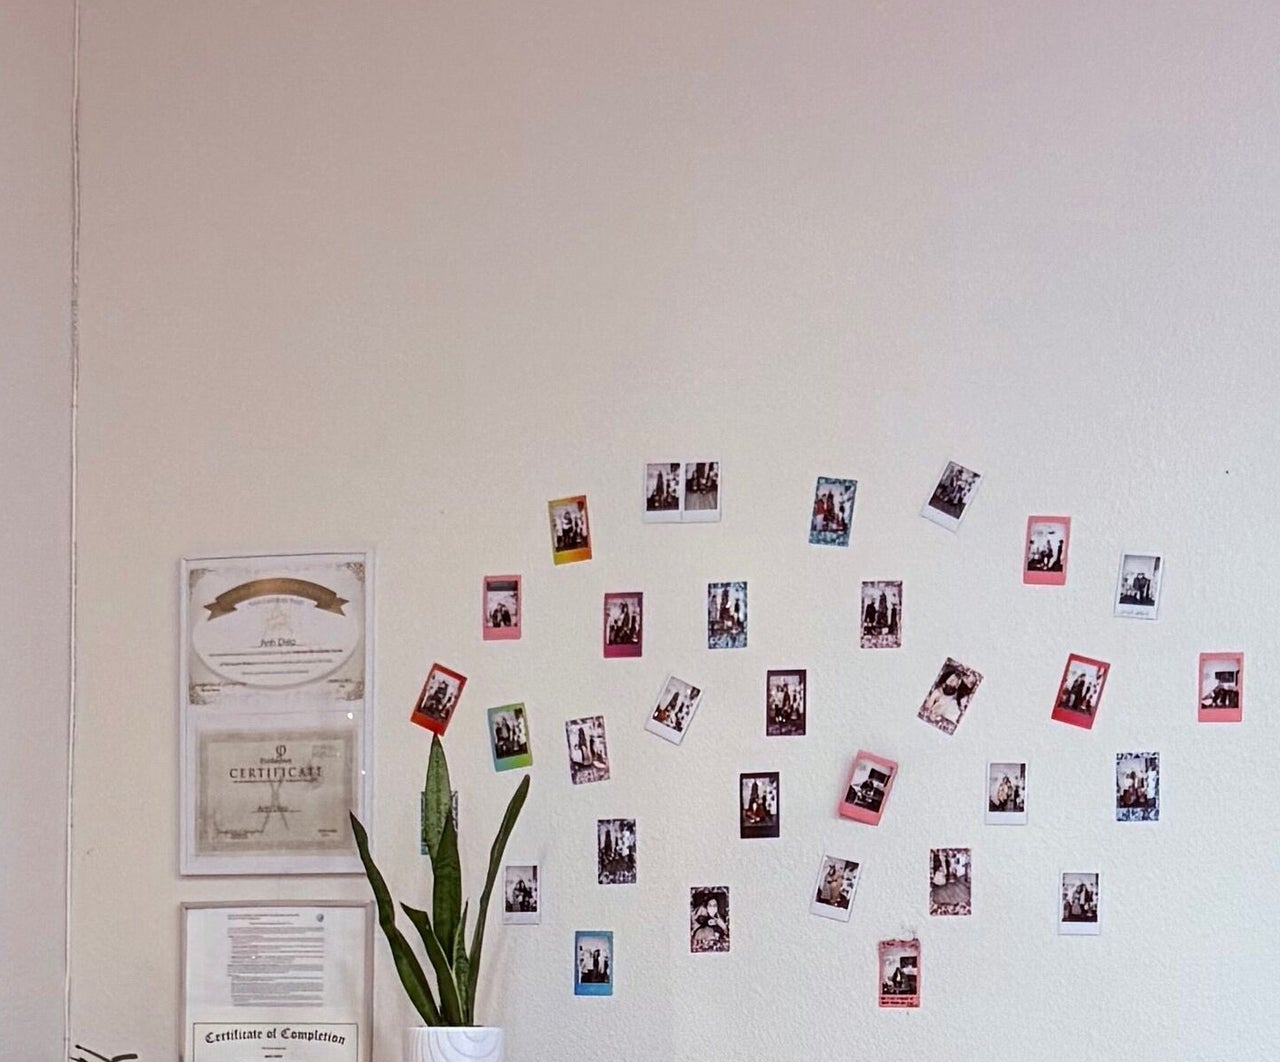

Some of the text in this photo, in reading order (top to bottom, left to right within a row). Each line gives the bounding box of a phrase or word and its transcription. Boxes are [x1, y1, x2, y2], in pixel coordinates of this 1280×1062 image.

[229, 766, 322, 779] CERTIFICATE
[205, 1028, 346, 1045] Certificate of Completion
